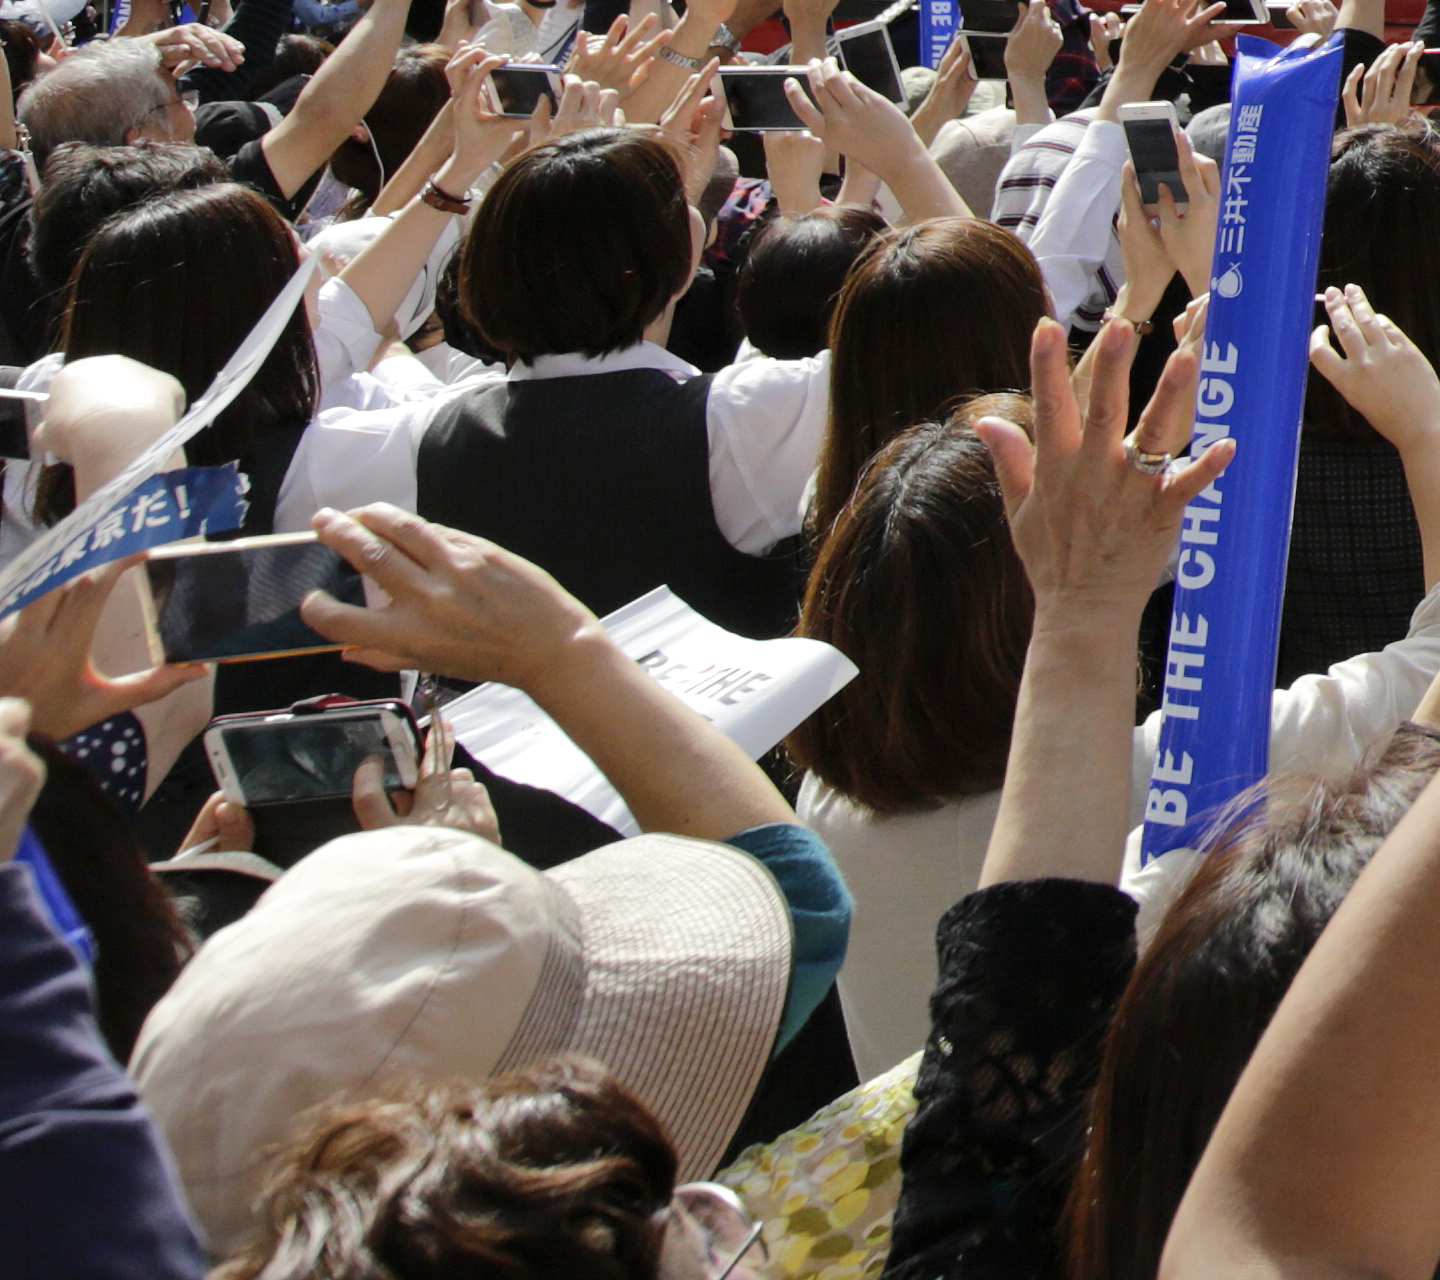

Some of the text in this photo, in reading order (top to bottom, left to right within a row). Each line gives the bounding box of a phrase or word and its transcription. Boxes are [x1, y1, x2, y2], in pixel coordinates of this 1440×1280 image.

[931, 1, 952, 27] BE
[1219, 103, 1264, 255] 三井不動産
[684, 667, 773, 707] THE
[1160, 610, 1210, 722] THE
[1144, 745, 1194, 828] BE
